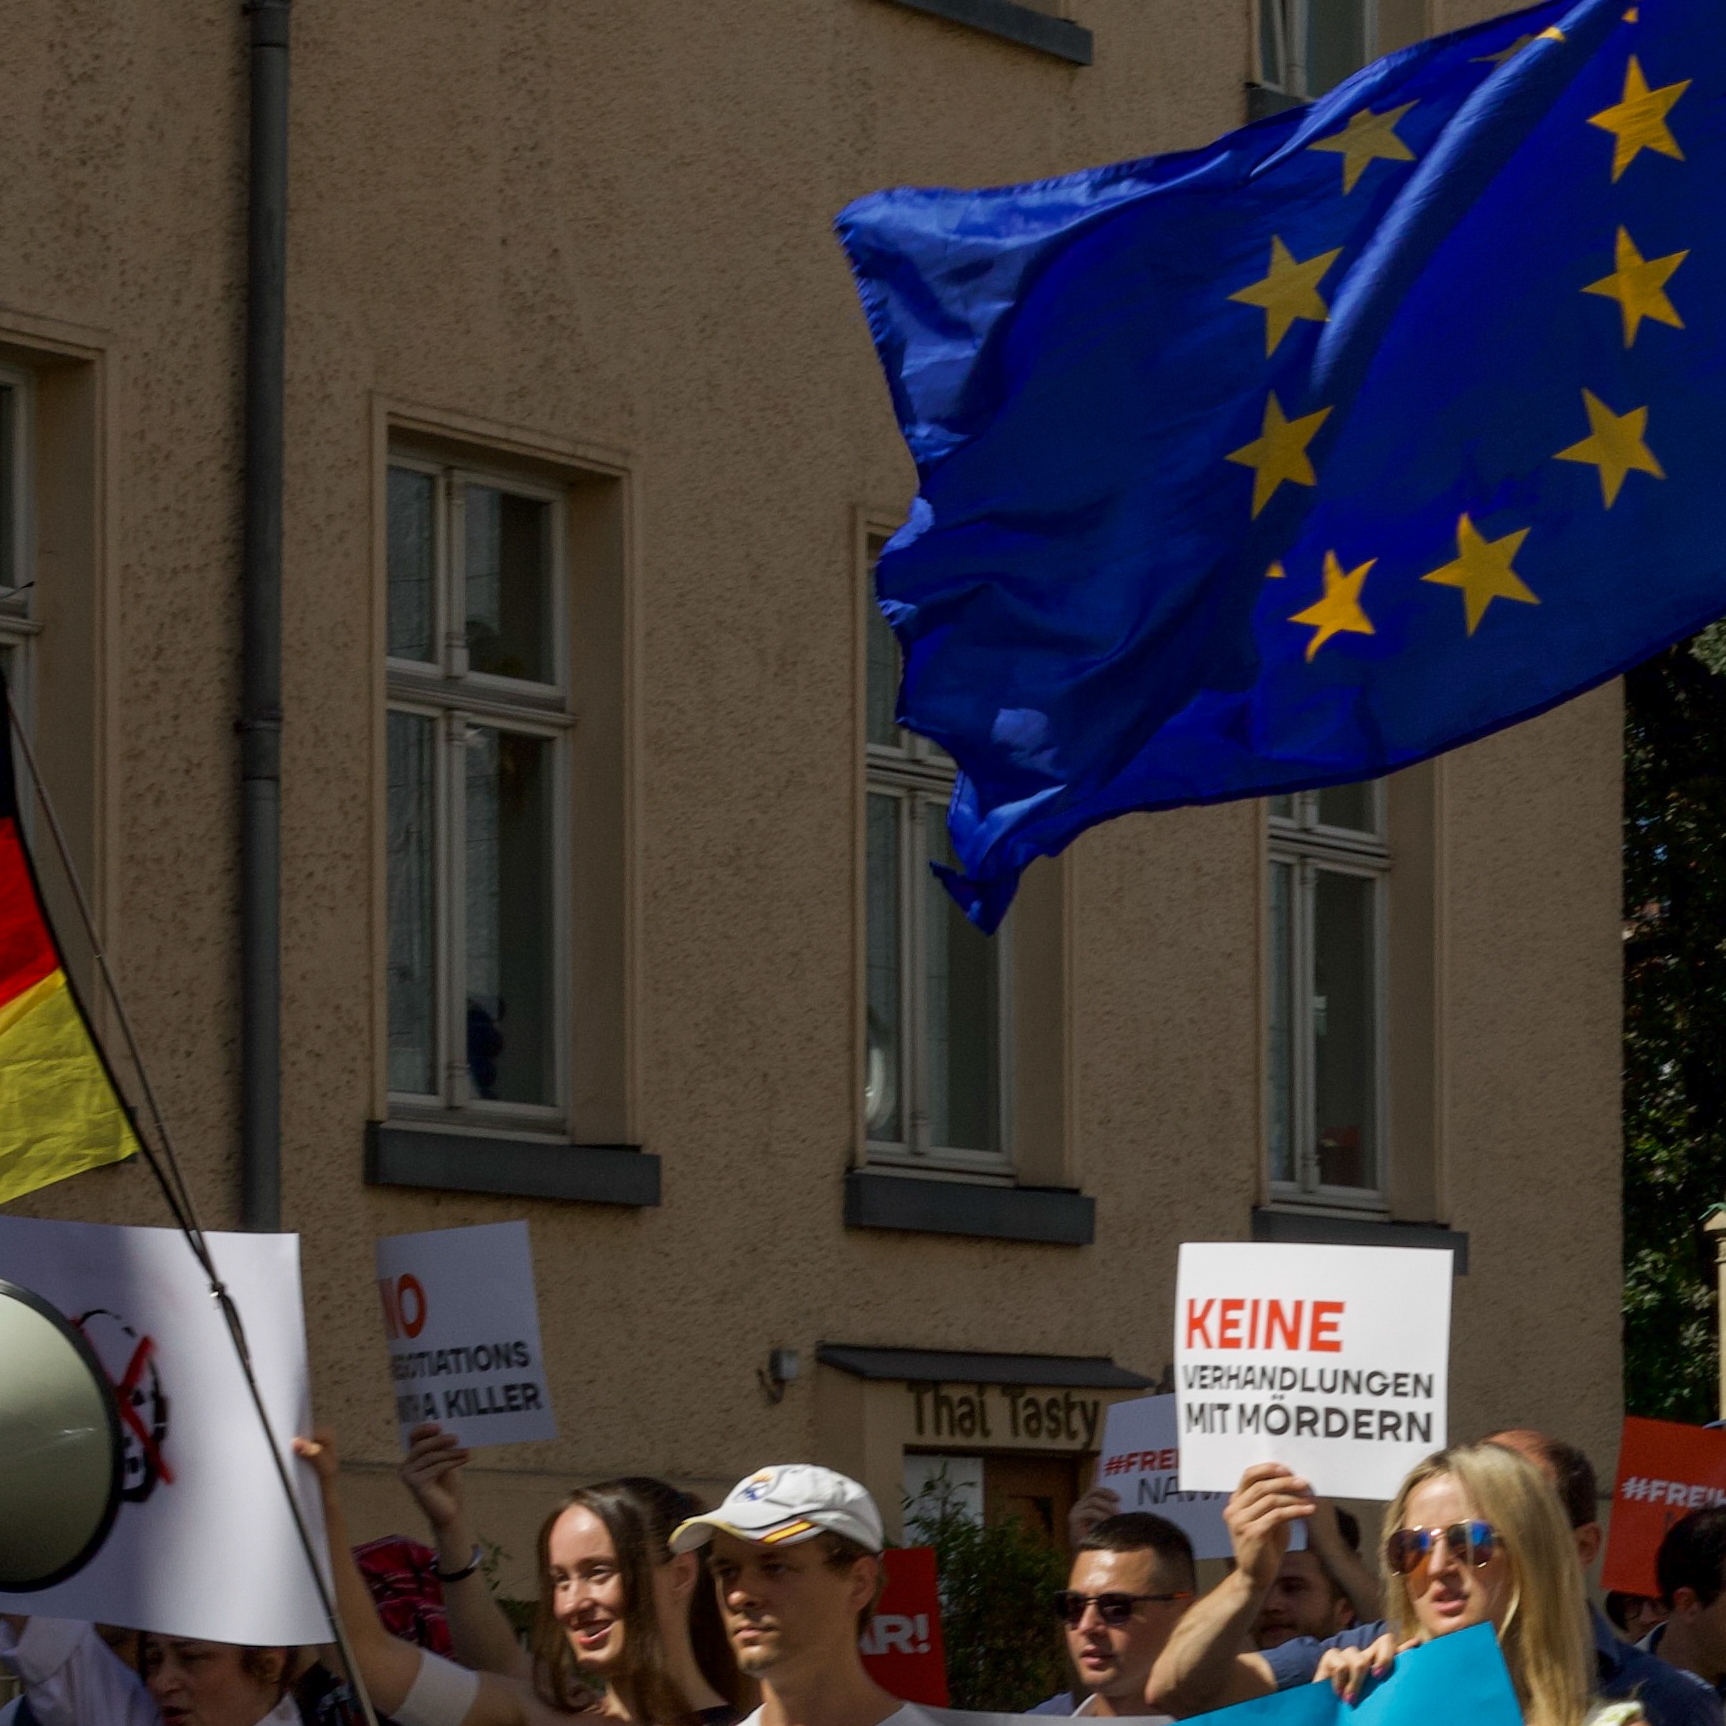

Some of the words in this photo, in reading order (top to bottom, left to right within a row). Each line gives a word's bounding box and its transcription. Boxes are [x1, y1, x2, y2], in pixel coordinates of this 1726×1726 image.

[1185, 1298, 1346, 1353] KEINE
[442, 1382, 543, 1419] KILLER
[1183, 1364, 1434, 1400] VERHANDLUNGEN
[908, 1384, 992, 1437] Thai
[1001, 1386, 1099, 1449] Tasty
[1186, 1403, 1232, 1435] MIT
[1238, 1393, 1433, 1444] MÖRDERN
